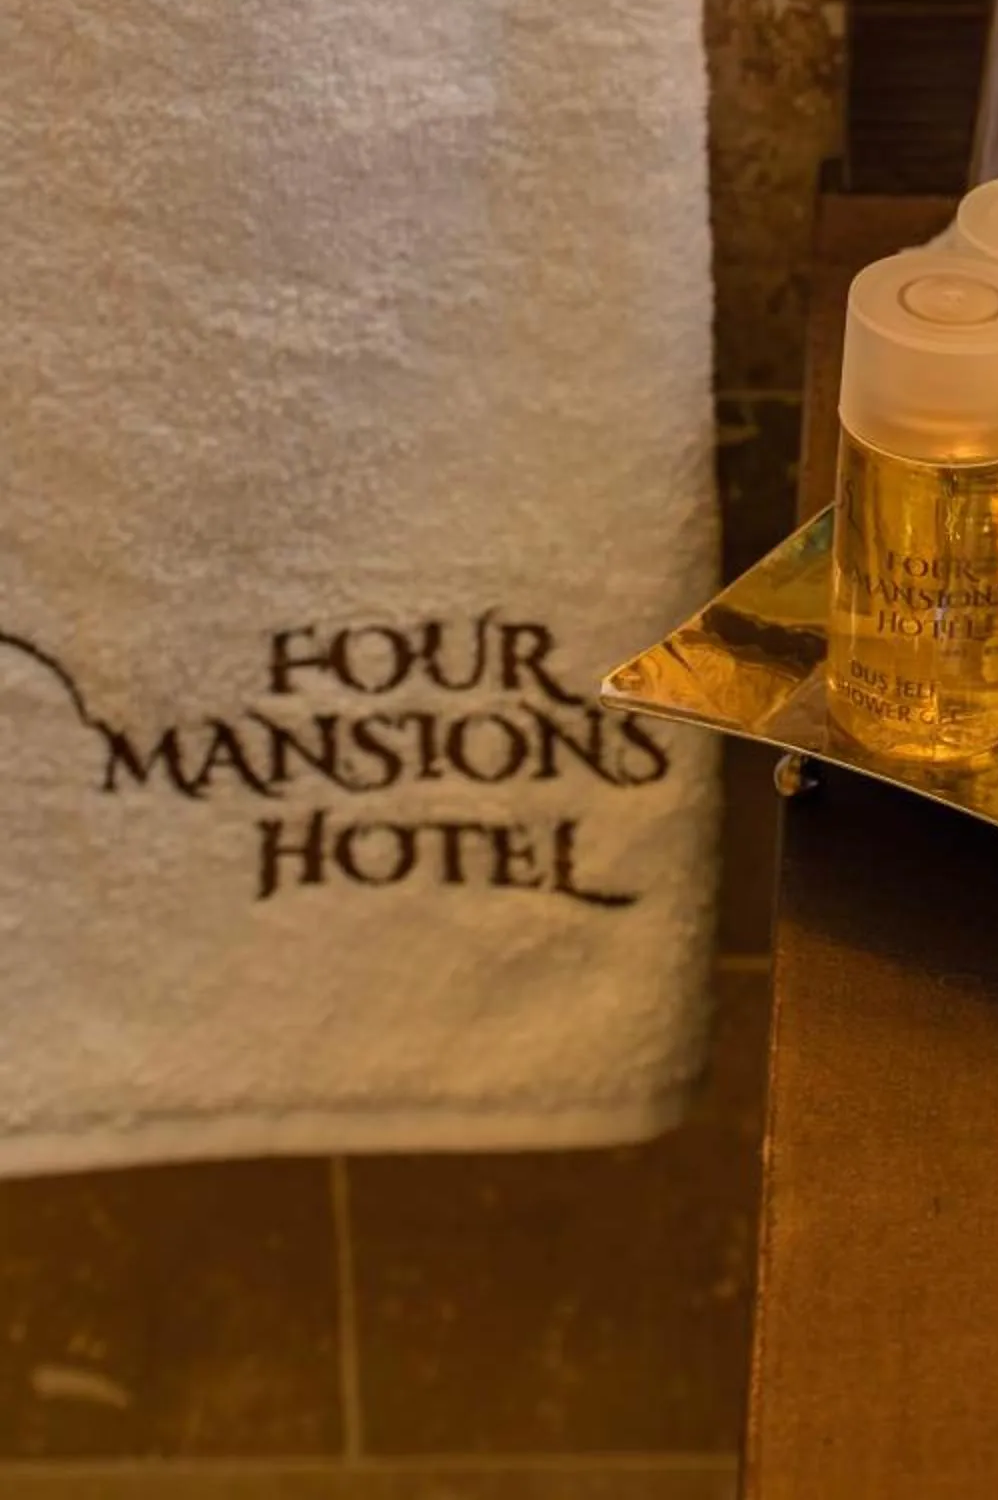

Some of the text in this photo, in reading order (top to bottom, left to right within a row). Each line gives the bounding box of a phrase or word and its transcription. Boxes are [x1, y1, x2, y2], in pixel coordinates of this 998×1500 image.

[886, 551, 981, 584] FOUR
[268, 607, 600, 706] FOUR
[102, 703, 671, 798] MANSIONS
[255, 809, 638, 907] HOTEL
